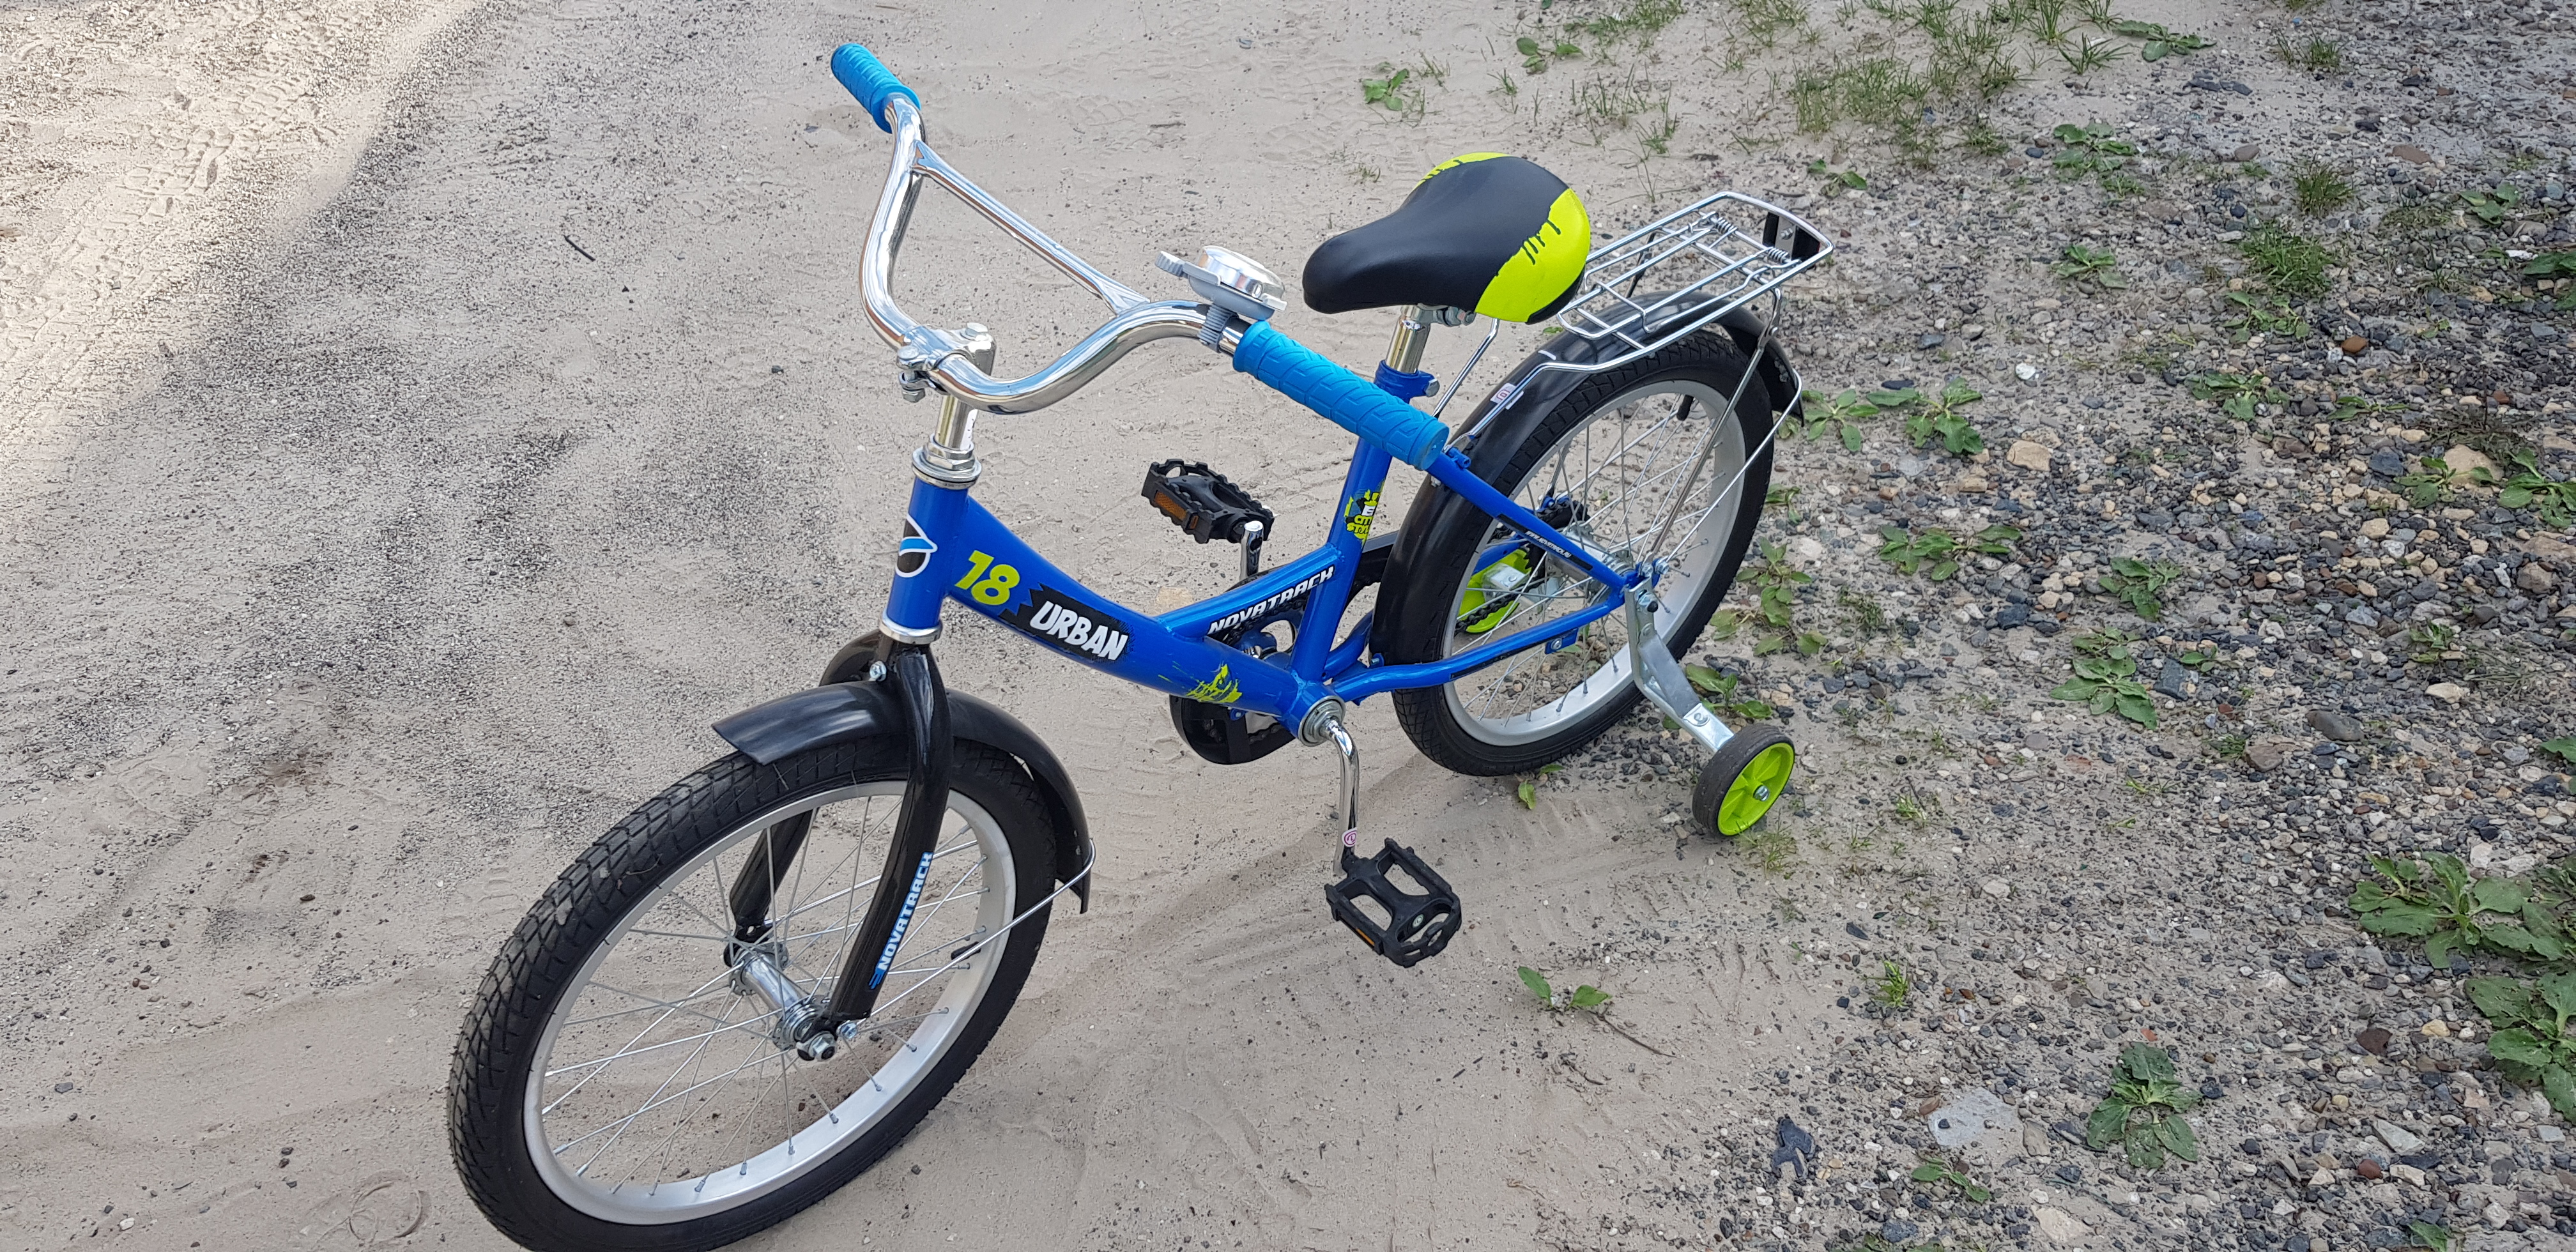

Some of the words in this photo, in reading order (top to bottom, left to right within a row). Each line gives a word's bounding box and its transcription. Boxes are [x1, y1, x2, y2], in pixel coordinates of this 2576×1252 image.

[954, 550, 1020, 605] 18
[1208, 566, 1334, 634] NOVATRACK
[1030, 600, 1128, 660] URBAN
[878, 853, 933, 970] NOVATRACK
